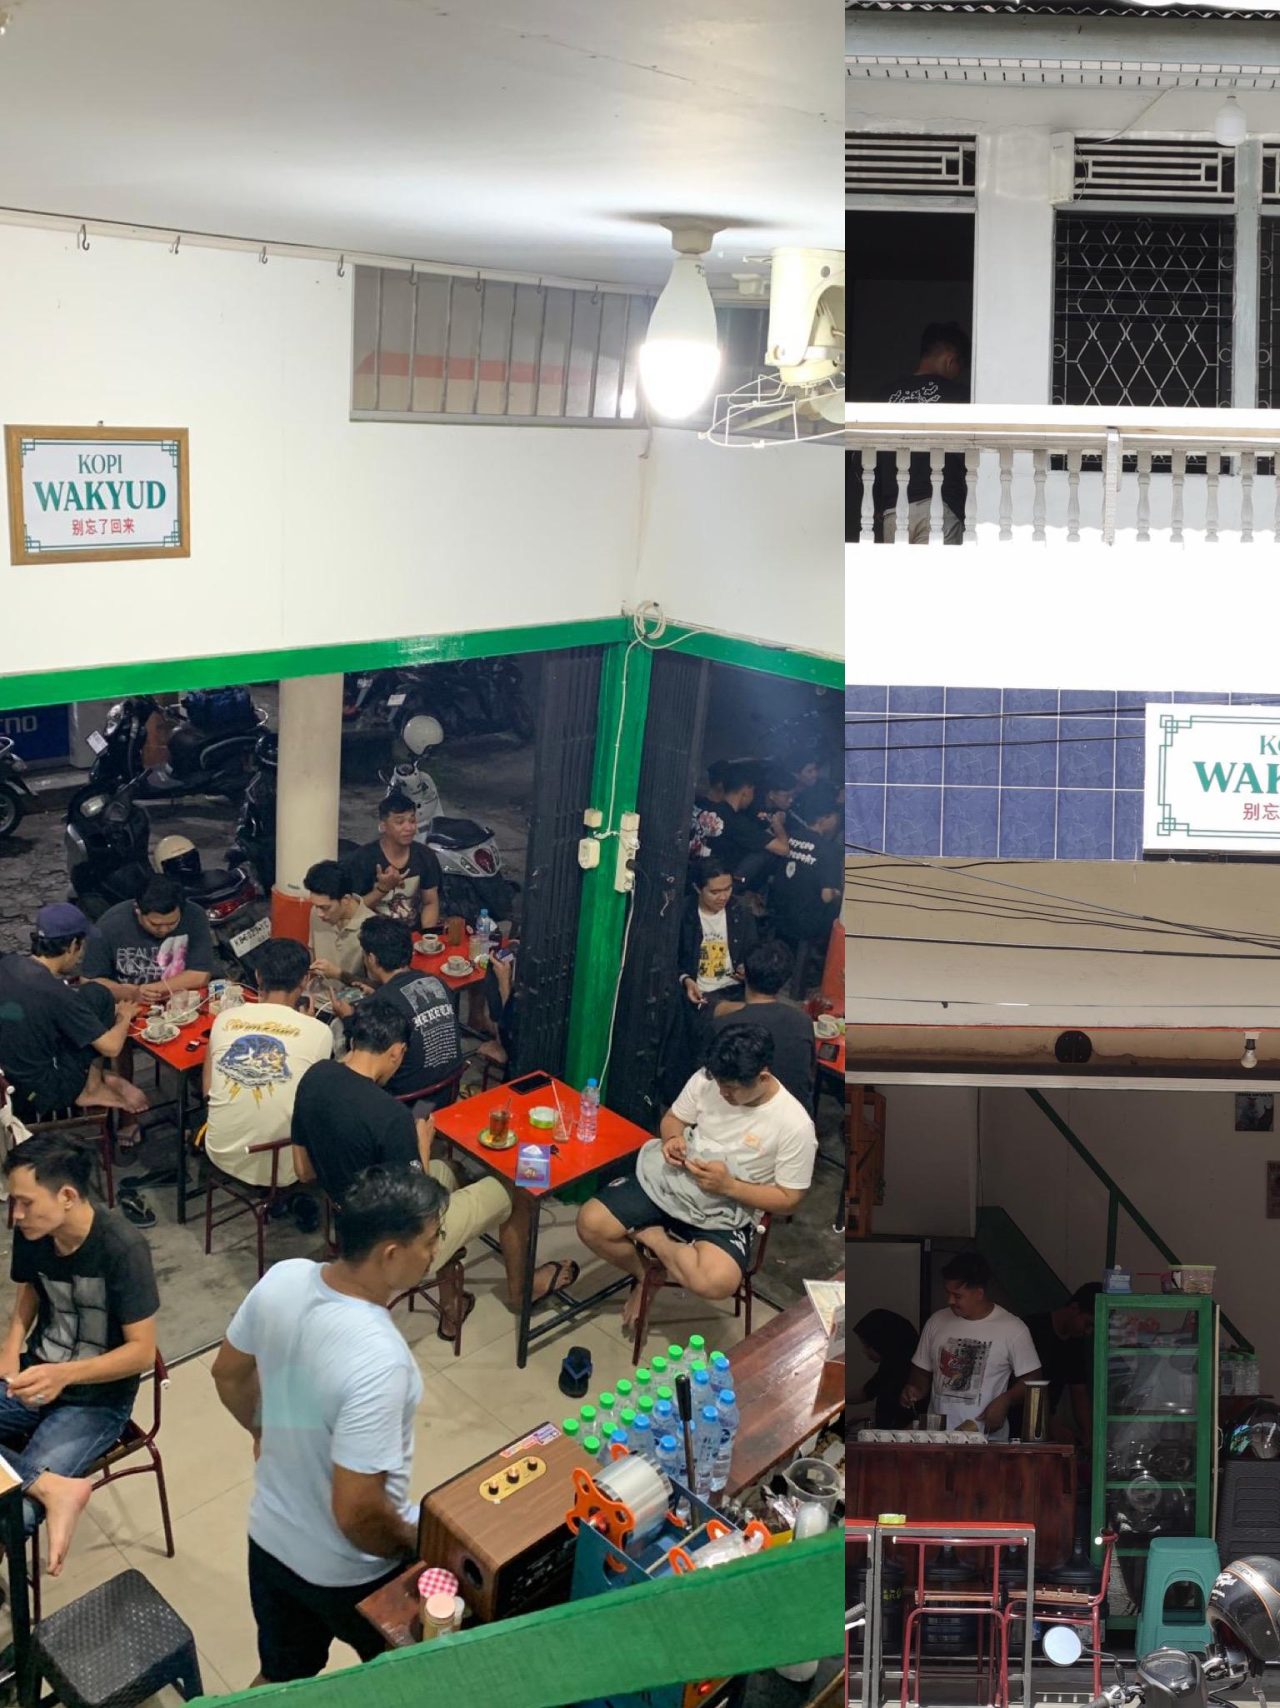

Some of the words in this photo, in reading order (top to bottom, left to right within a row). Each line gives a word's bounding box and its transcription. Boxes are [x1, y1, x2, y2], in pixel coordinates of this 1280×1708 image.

[78, 454, 123, 475] KOPI
[32, 480, 167, 512] WAKYUD
[72, 518, 136, 536] 别忘了回来
